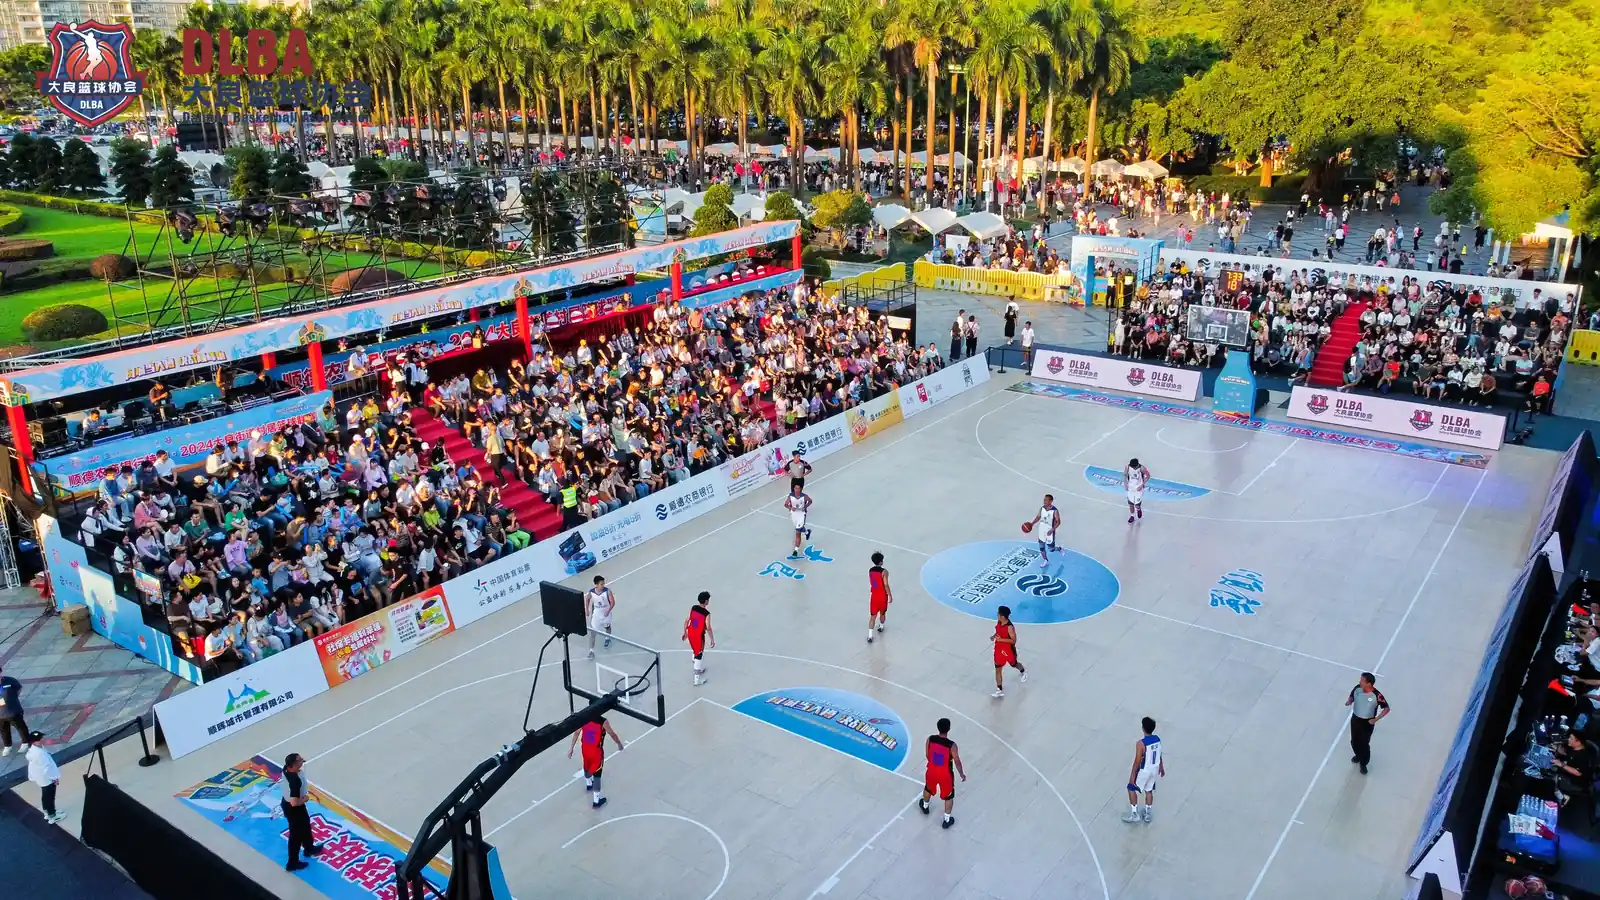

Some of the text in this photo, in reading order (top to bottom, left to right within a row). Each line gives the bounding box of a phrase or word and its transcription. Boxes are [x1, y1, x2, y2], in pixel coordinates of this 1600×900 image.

[1226, 271, 1242, 281] 7:33
[1069, 359, 1091, 371] DLBA
[1151, 371, 1174, 383] DLBA
[1335, 398, 1363, 412] DLBA
[1334, 408, 1373, 420] 大良篮球协会
[1441, 413, 1471, 428] DLBA
[1440, 424, 1482, 437] 大良篮球协会
[668, 483, 715, 511] 顺德农商银行
[489, 562, 532, 586] 中国体育彩票
[207, 690, 294, 736] 顺晖城市管理有限公司
